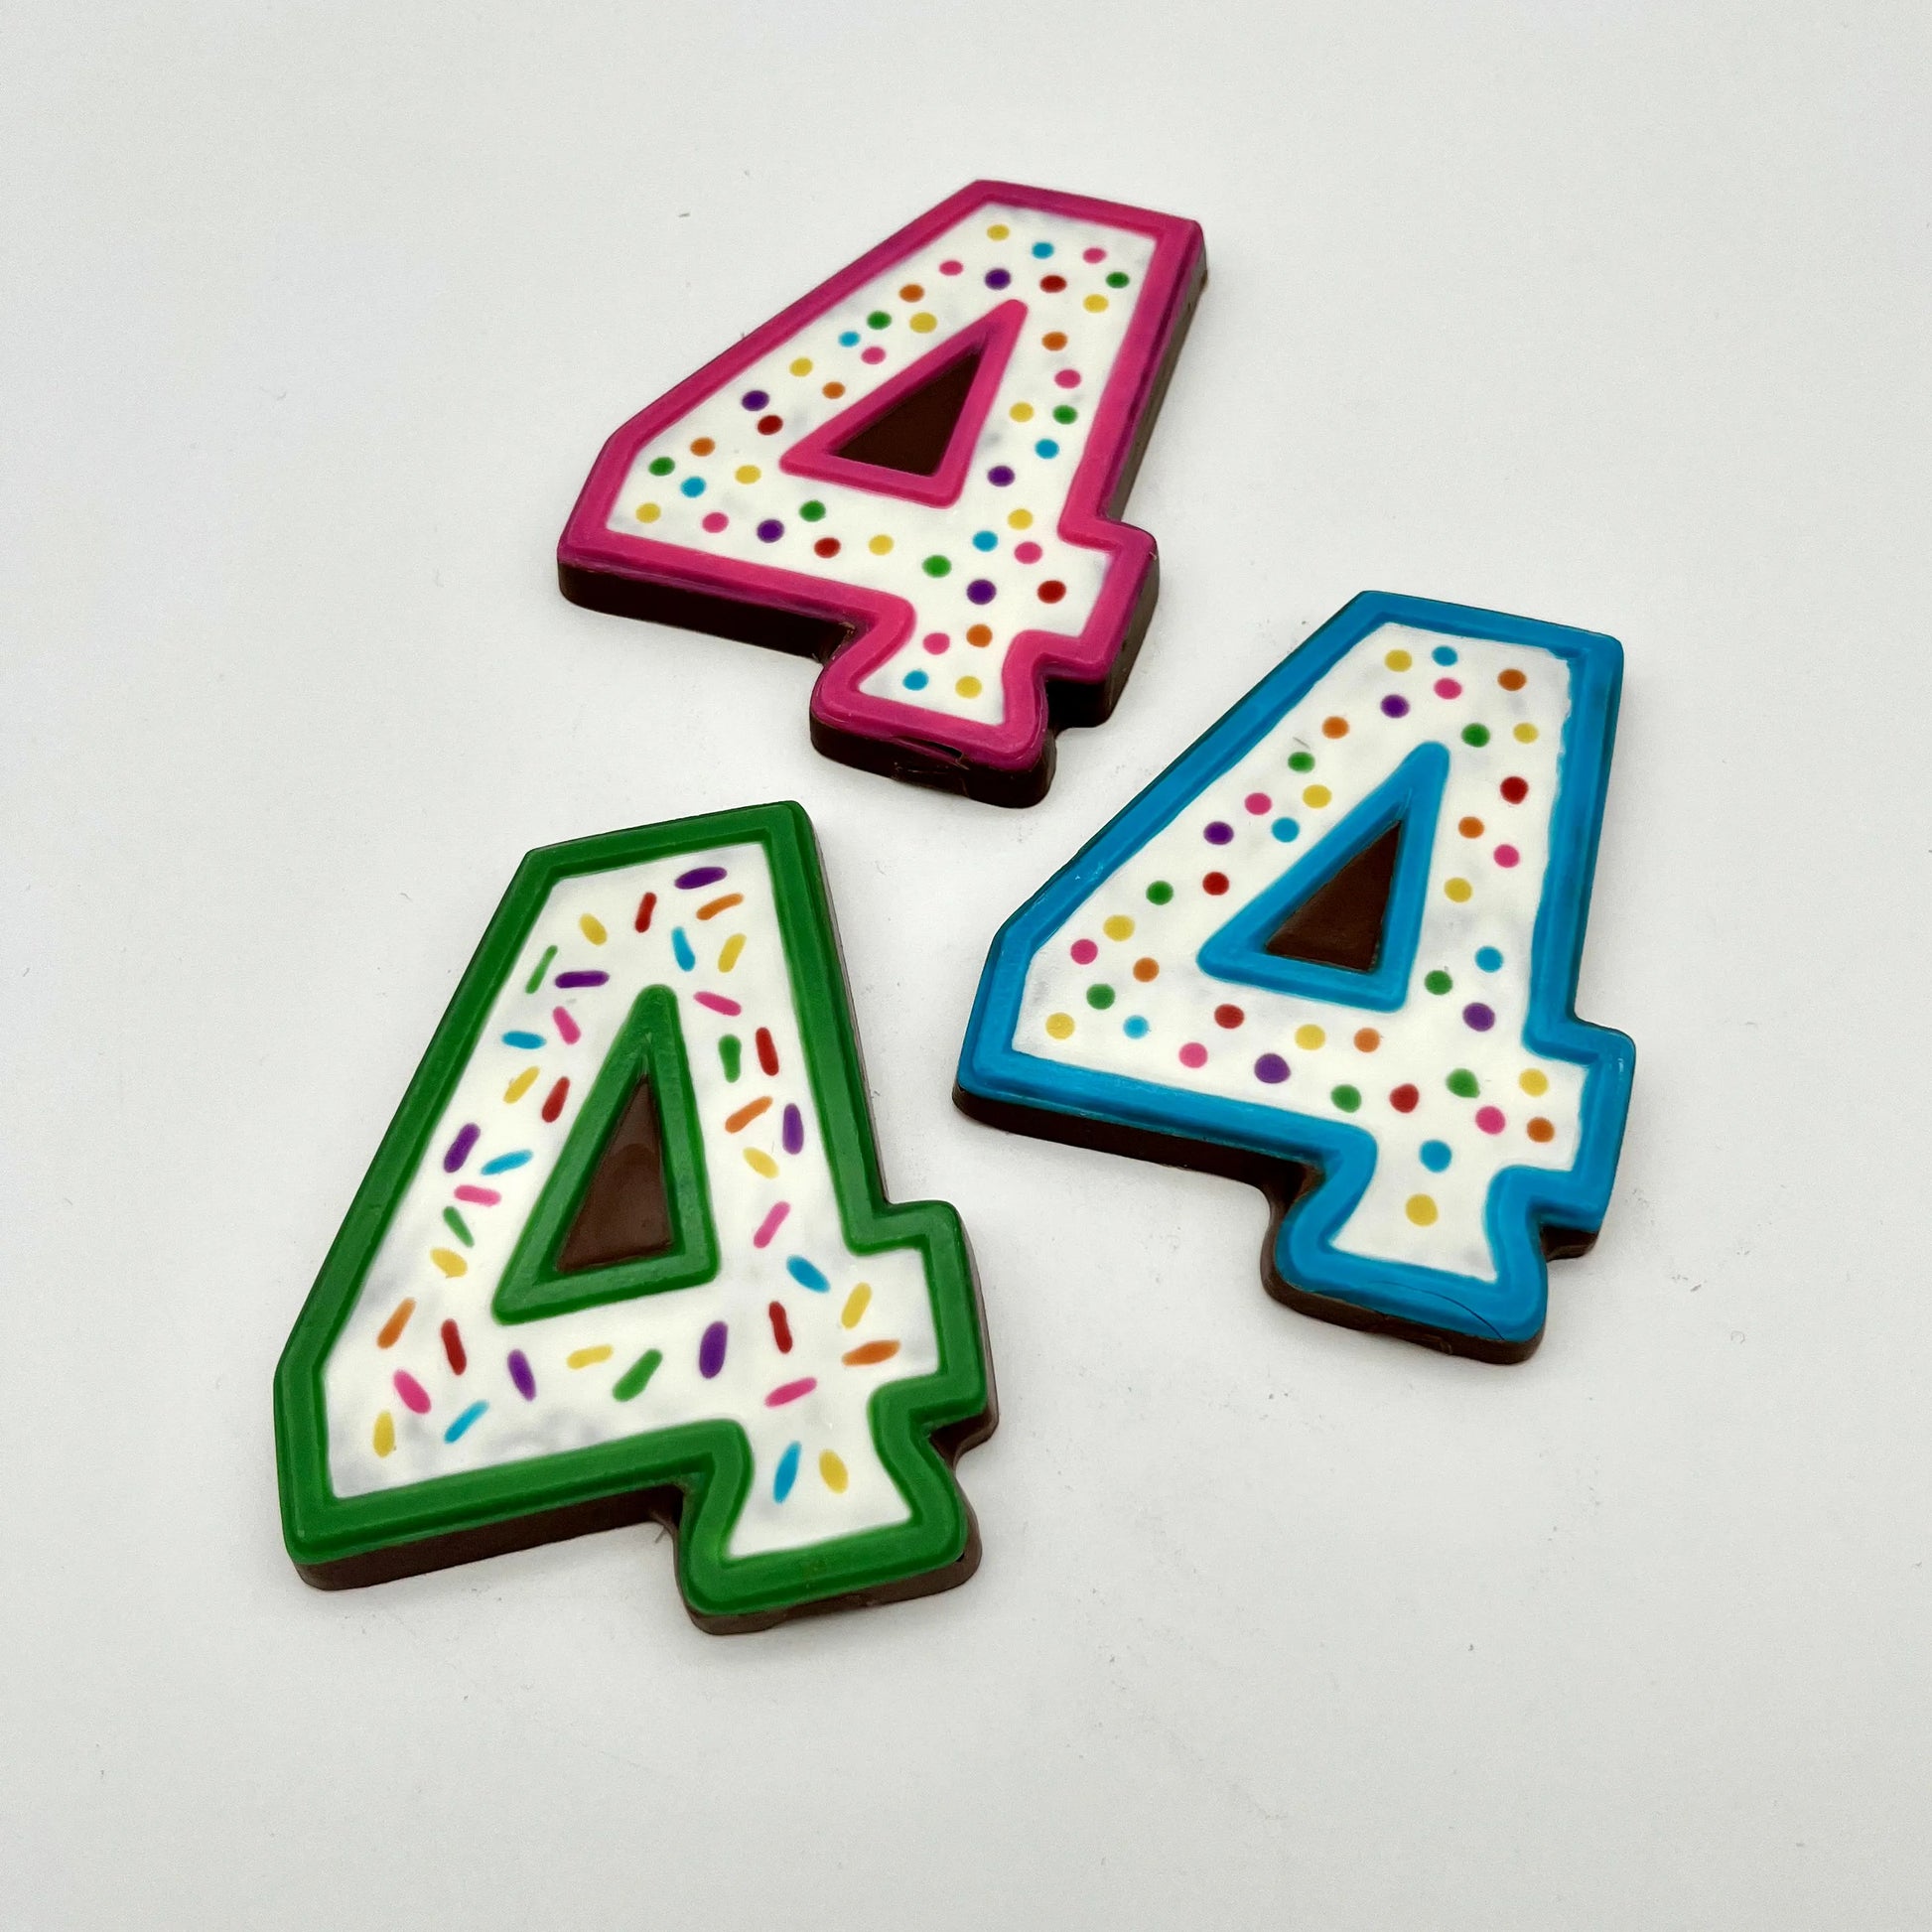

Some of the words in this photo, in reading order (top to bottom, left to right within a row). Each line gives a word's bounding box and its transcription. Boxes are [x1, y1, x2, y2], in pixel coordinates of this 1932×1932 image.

[558, 181, 1208, 808] 4
[274, 801, 997, 1636] 4
[956, 591, 1636, 1364] 4
